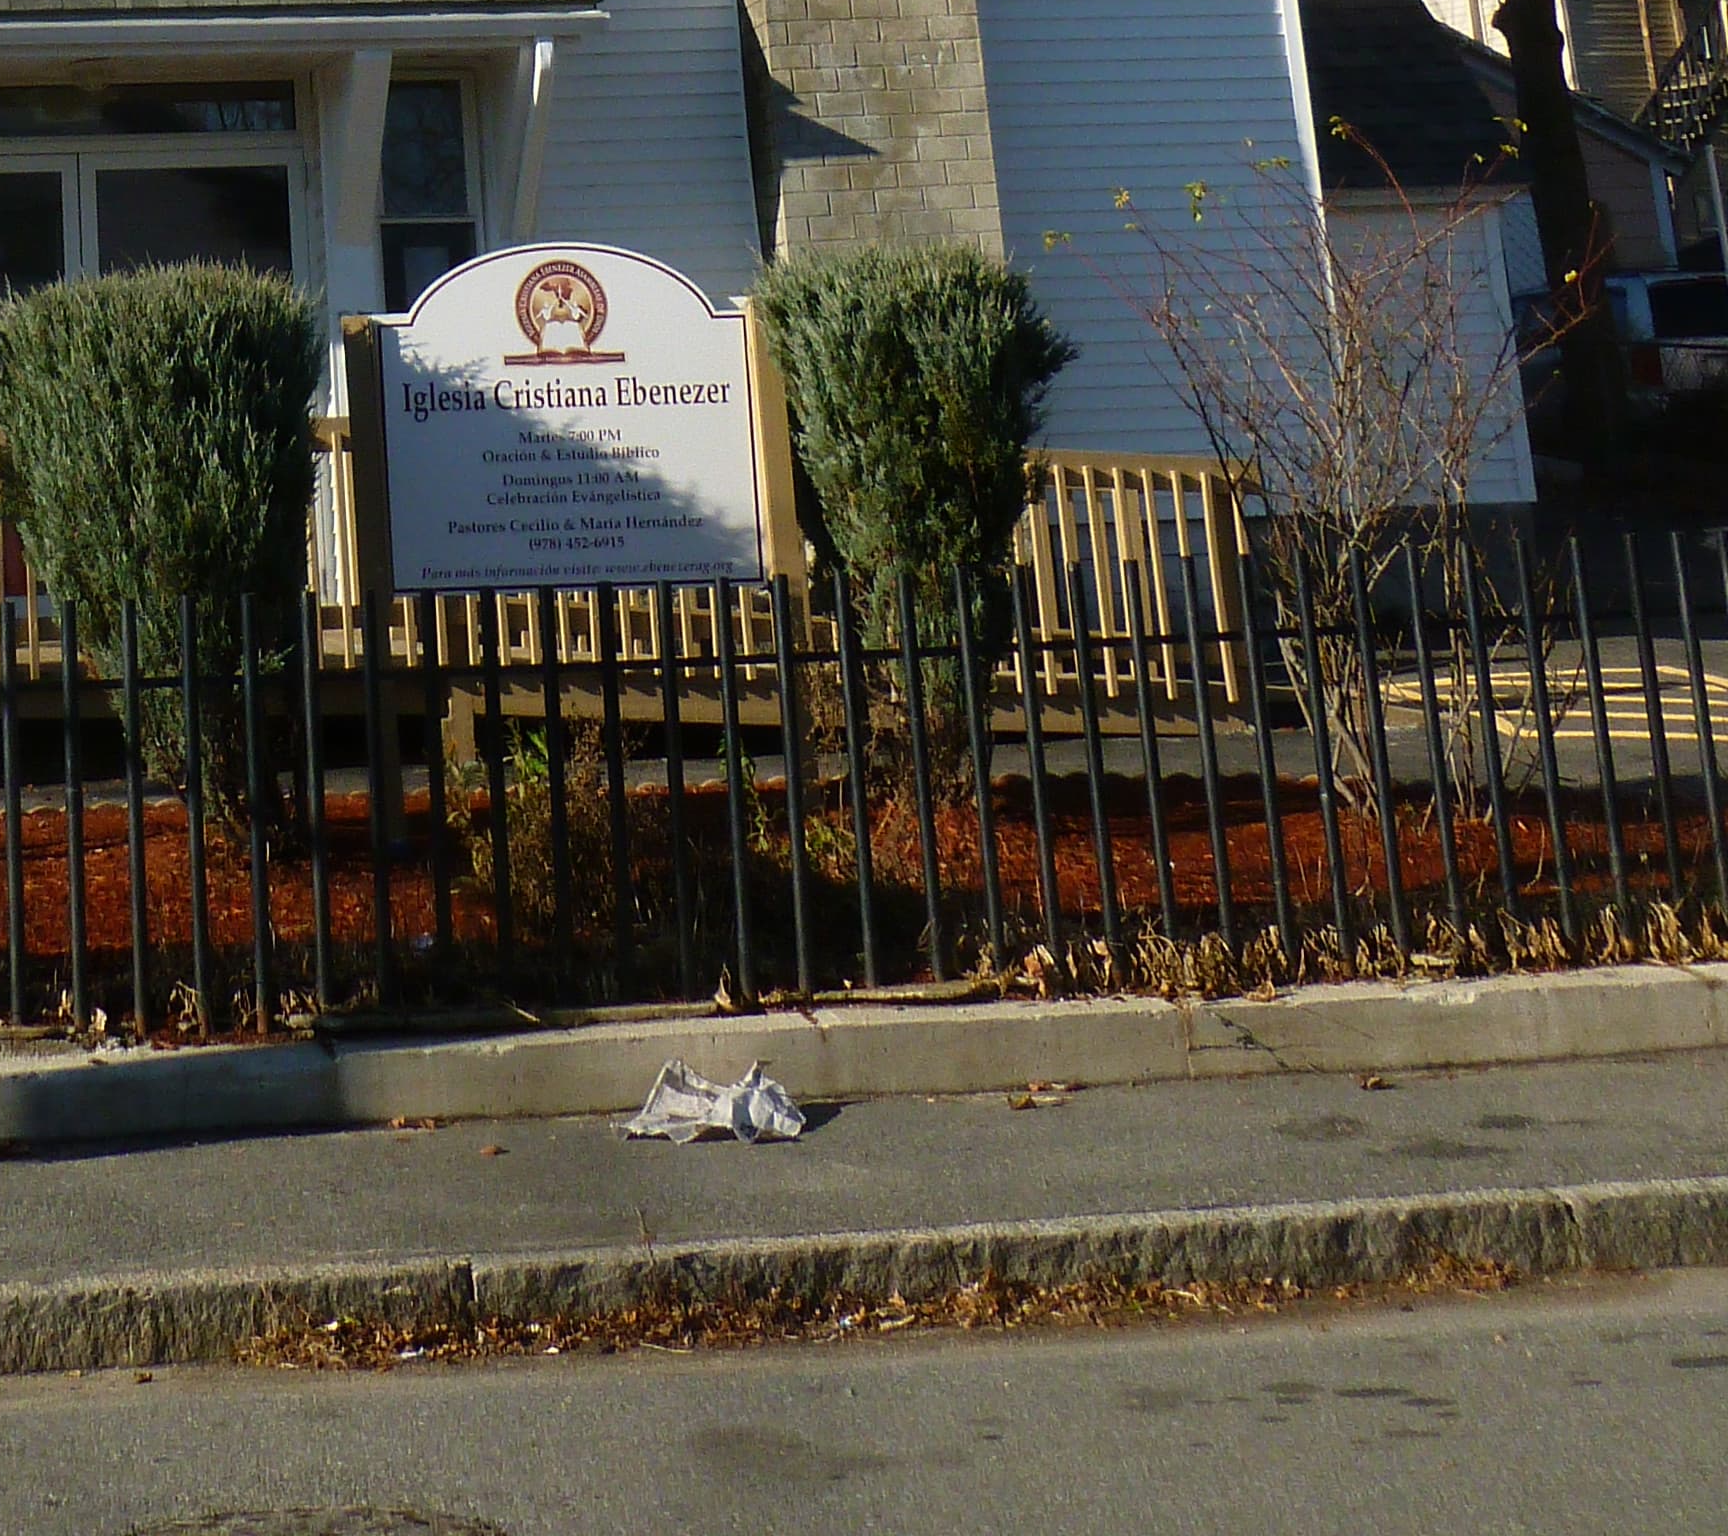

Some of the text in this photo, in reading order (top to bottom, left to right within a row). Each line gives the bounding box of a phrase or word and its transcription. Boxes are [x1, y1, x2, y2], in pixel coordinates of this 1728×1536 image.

[402, 376, 730, 422] Iglesia Cristiana Ebenezer
[519, 429, 621, 443] Martes 7:00 PM
[541, 450, 551, 461] &
[557, 446, 608, 461] Estudio
[503, 475, 572, 488] Domingos
[615, 471, 639, 483] AM
[448, 521, 506, 534] Pastores
[510, 518, 560, 532] Cecilio
[564, 518, 576, 531] &
[529, 535, 624, 551] (978) 452-6915
